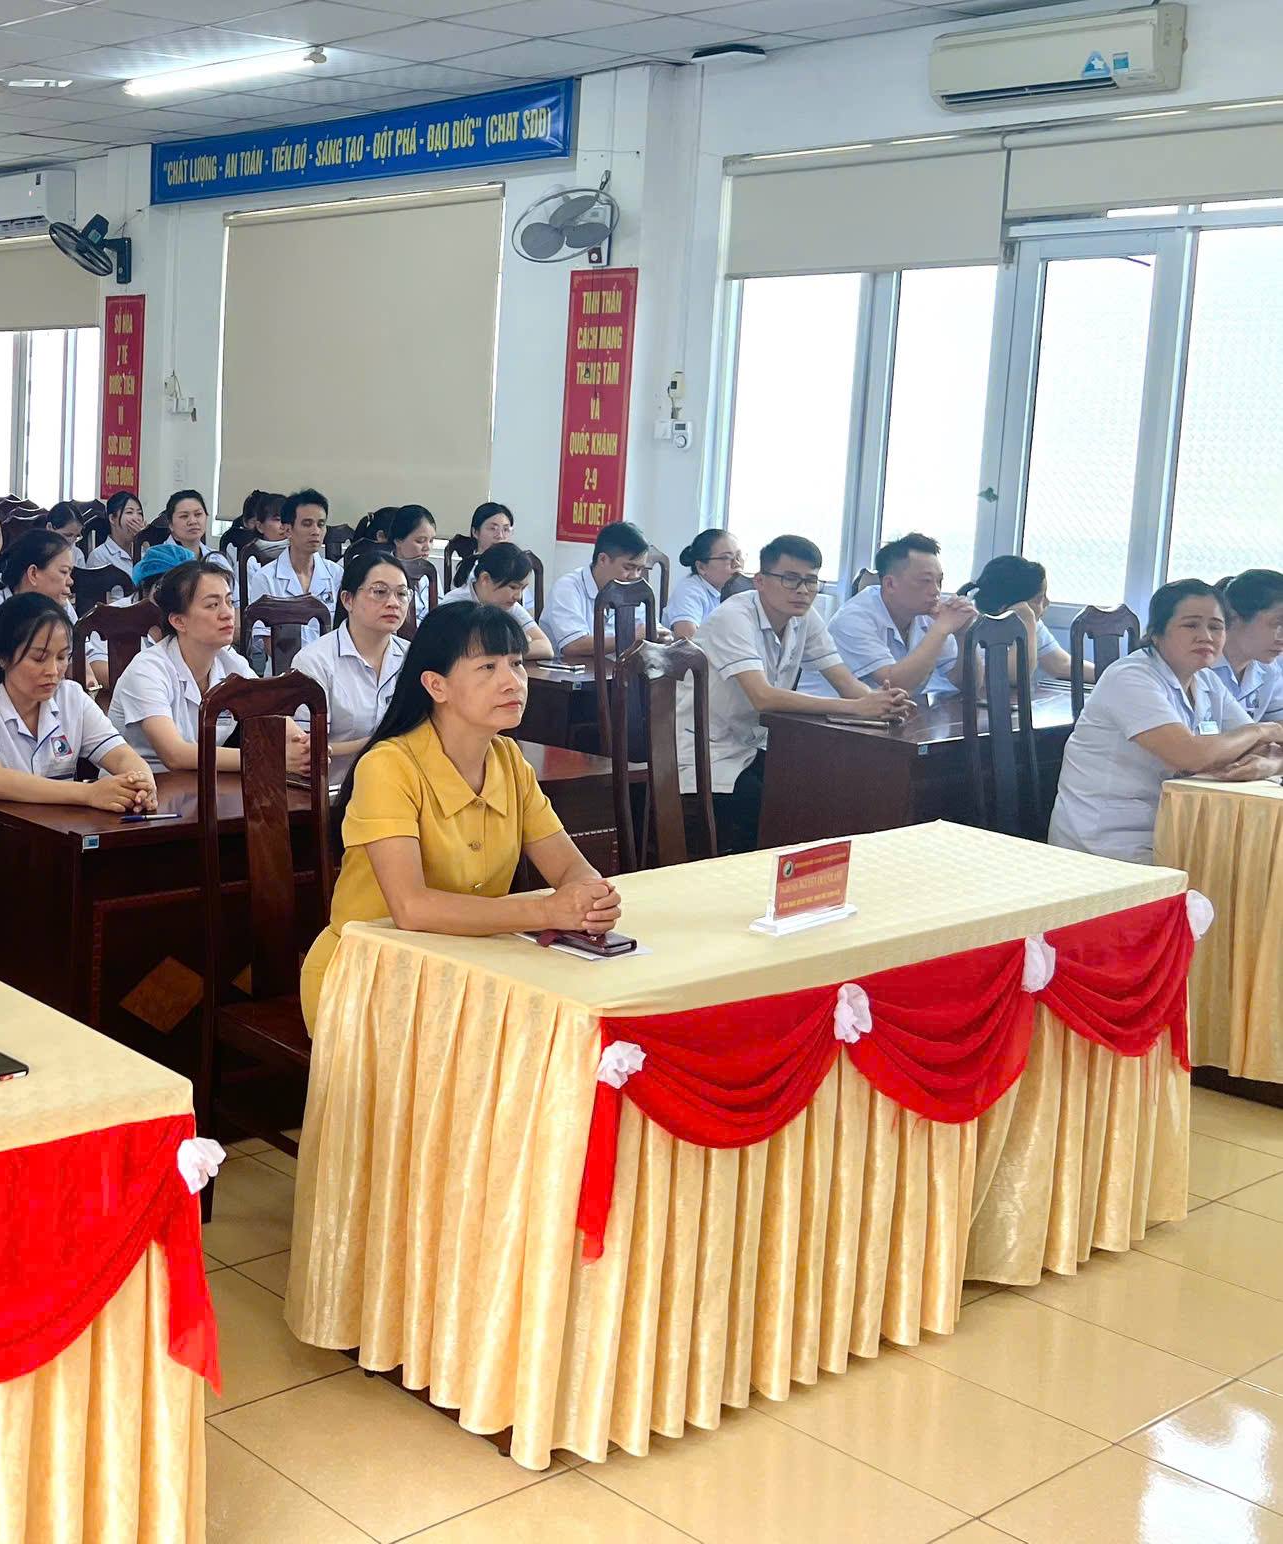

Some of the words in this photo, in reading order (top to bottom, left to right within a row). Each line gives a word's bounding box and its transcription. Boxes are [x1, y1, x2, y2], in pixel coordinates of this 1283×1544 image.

[190, 154, 217, 187] LƯỢNG
[224, 152, 238, 179] AN
[240, 145, 264, 176] TOÀN
[272, 138, 293, 172] TIẾN
[294, 137, 308, 175] ĐỘ
[315, 134, 343, 166] SÁNG
[345, 134, 365, 168] TẠO
[373, 125, 394, 165] ĐỘT
[395, 121, 418, 157] PHÁ
[427, 122, 450, 158] ĐẠO
[486, 111, 520, 147] (CHAT
[582, 291, 600, 314] TINH
[577, 321, 598, 350] CÁCH
[598, 326, 623, 354] MẠNG
[576, 357, 601, 385] THÁNG
[603, 356, 620, 385] TÁM
[590, 391, 600, 420] VÀ
[569, 424, 590, 457] QUỐC
[590, 427, 618, 456] KHÁNH
[584, 467, 597, 491] 2-9
[573, 493, 588, 525] BẤT
[588, 498, 606, 531] DIỆT
